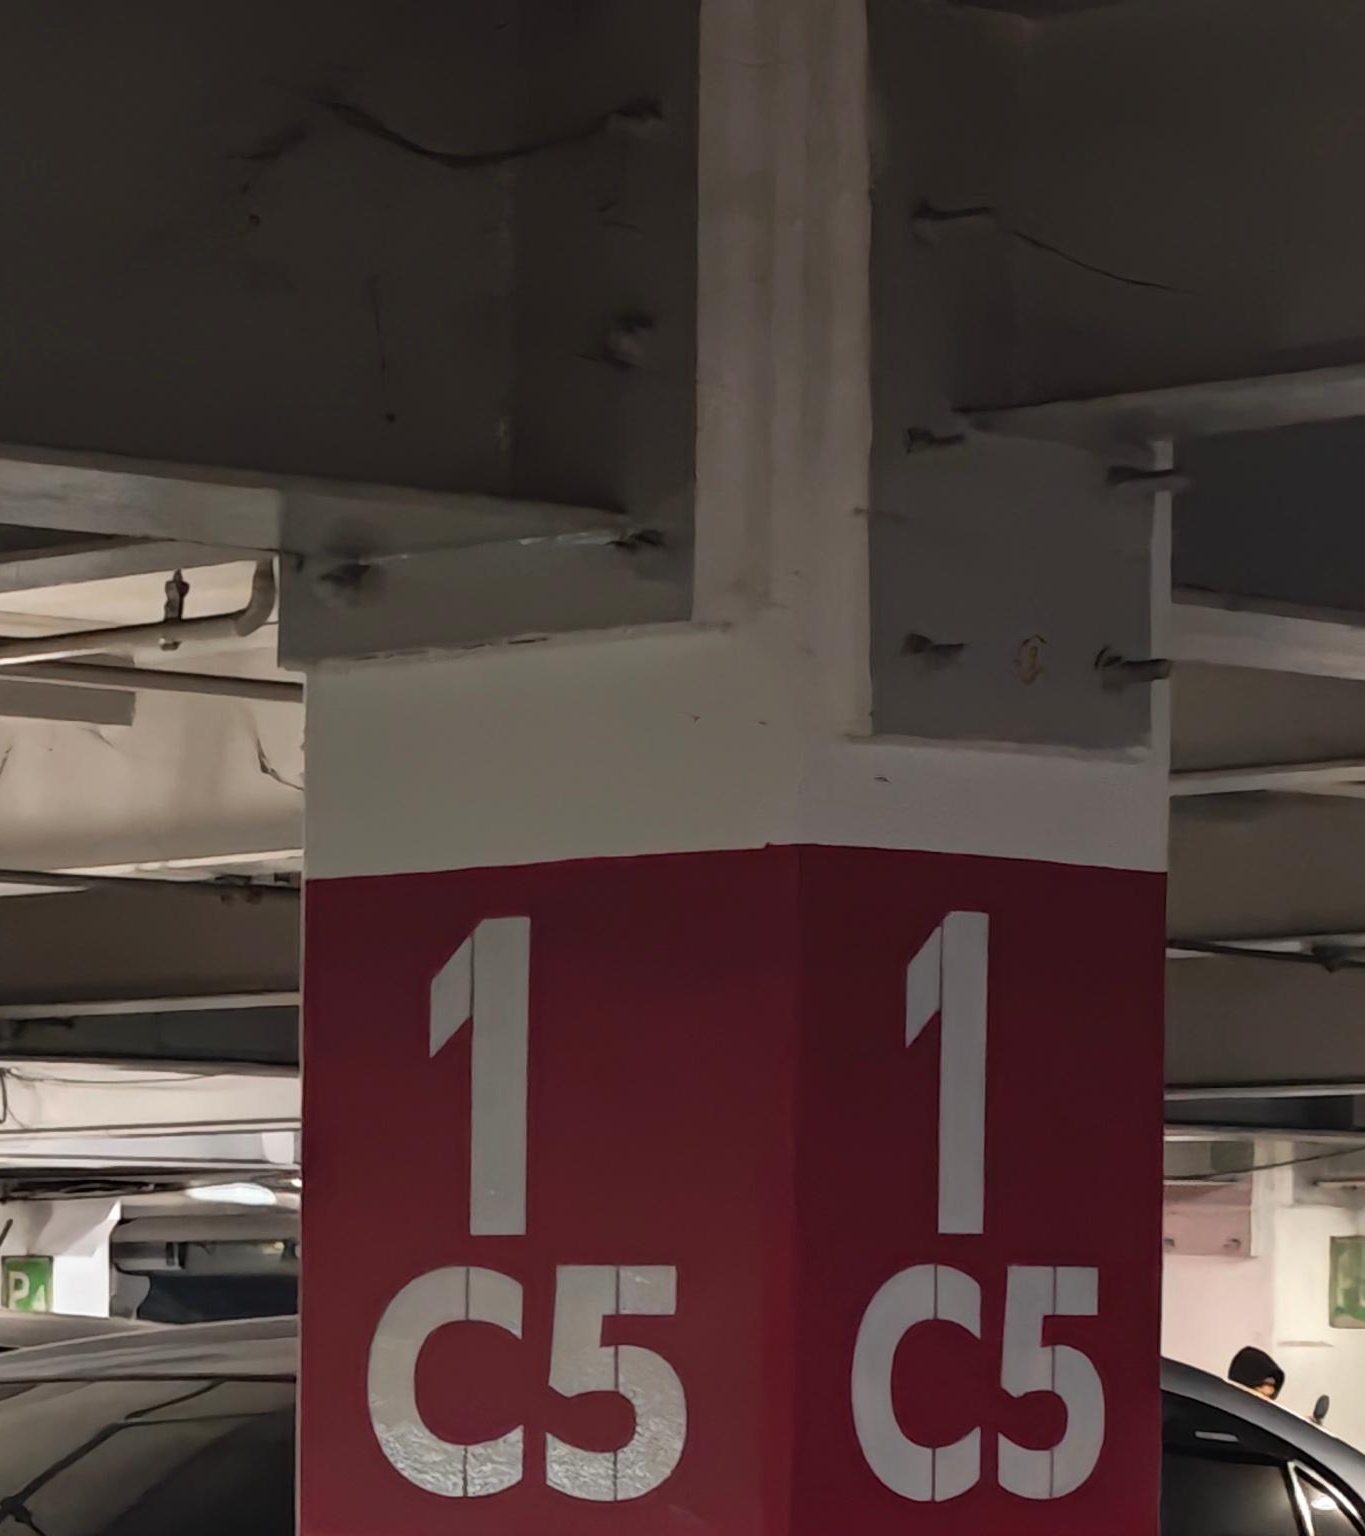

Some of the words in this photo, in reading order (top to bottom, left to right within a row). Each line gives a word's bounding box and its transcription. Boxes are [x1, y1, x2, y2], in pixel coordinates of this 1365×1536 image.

[428, 915, 532, 1236] 1
[903, 910, 990, 1235] 1
[366, 1264, 688, 1502] C5
[850, 1262, 1106, 1503] C5
